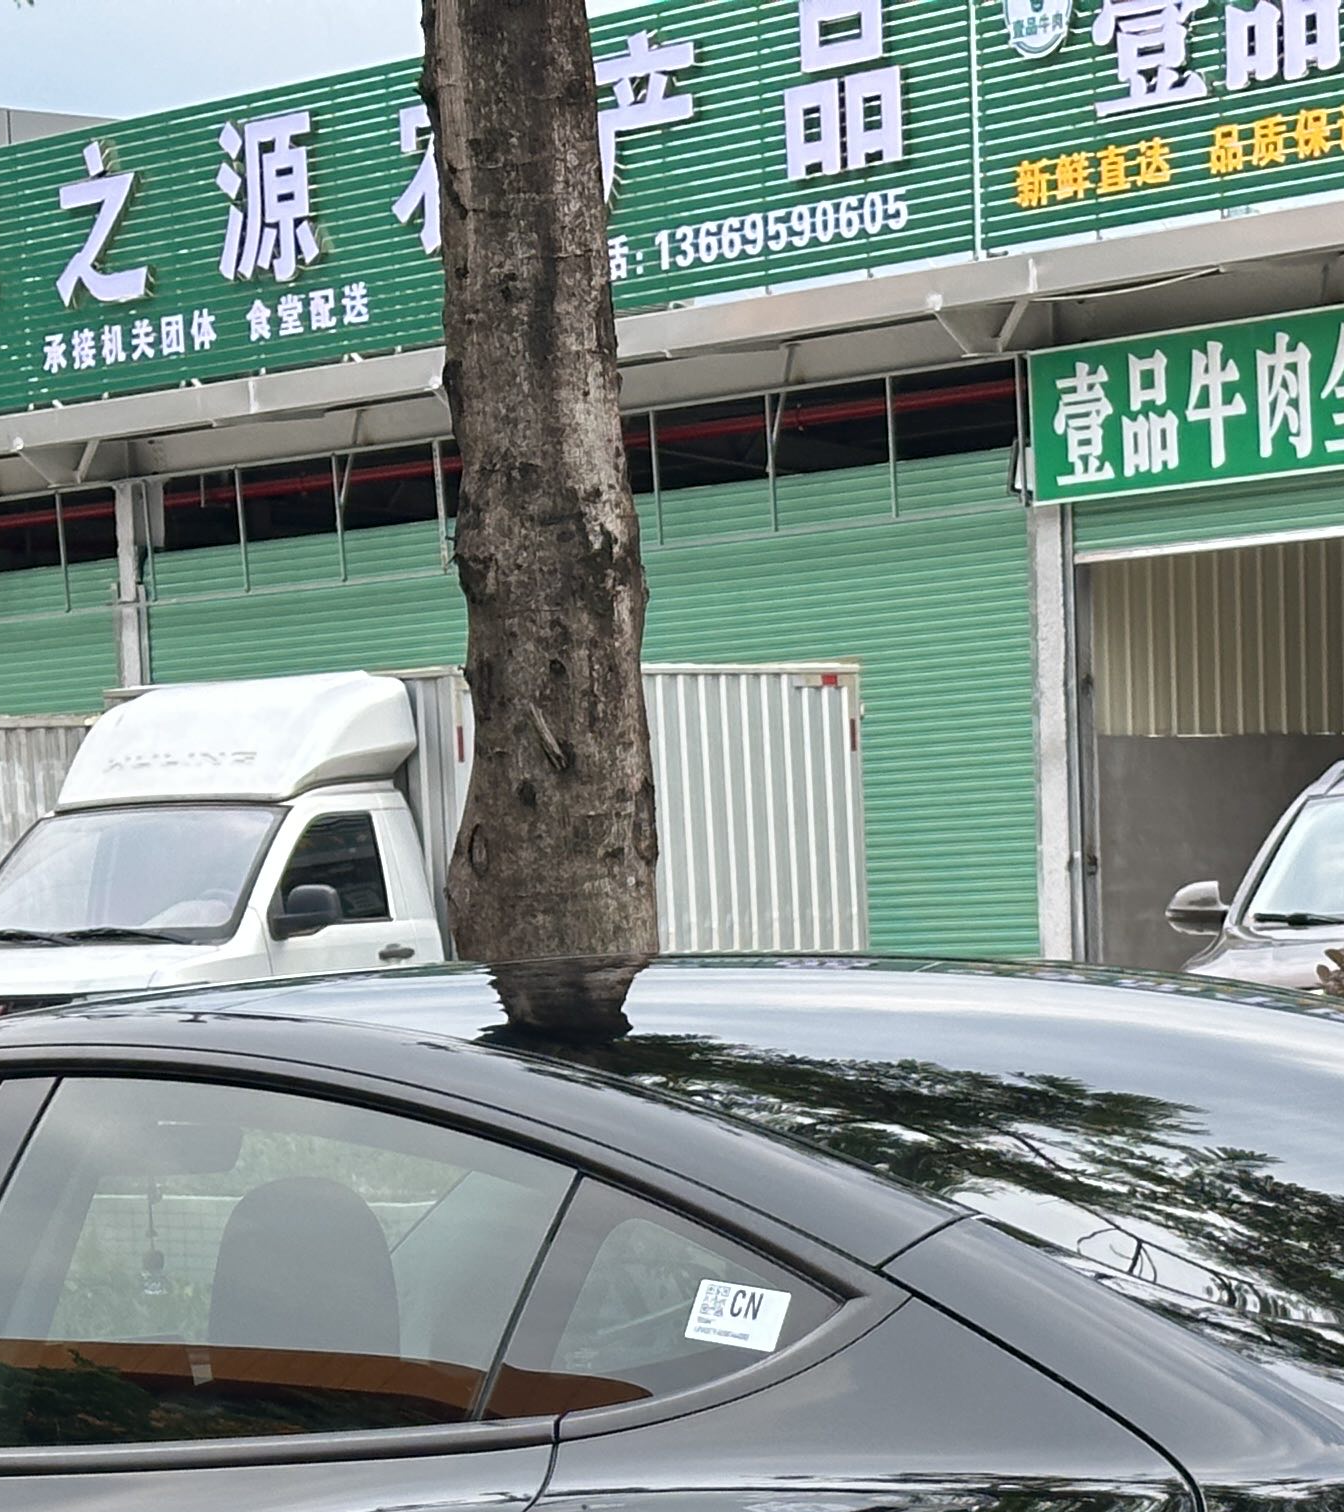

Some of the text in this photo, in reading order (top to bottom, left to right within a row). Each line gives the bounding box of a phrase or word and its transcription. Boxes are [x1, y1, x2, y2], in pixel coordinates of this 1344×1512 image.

[1016, 136, 1172, 208] 新鲜直达
[43, 282, 370, 373] 承接机关团体 食堂配送
[729, 1289, 765, 1321] CN
